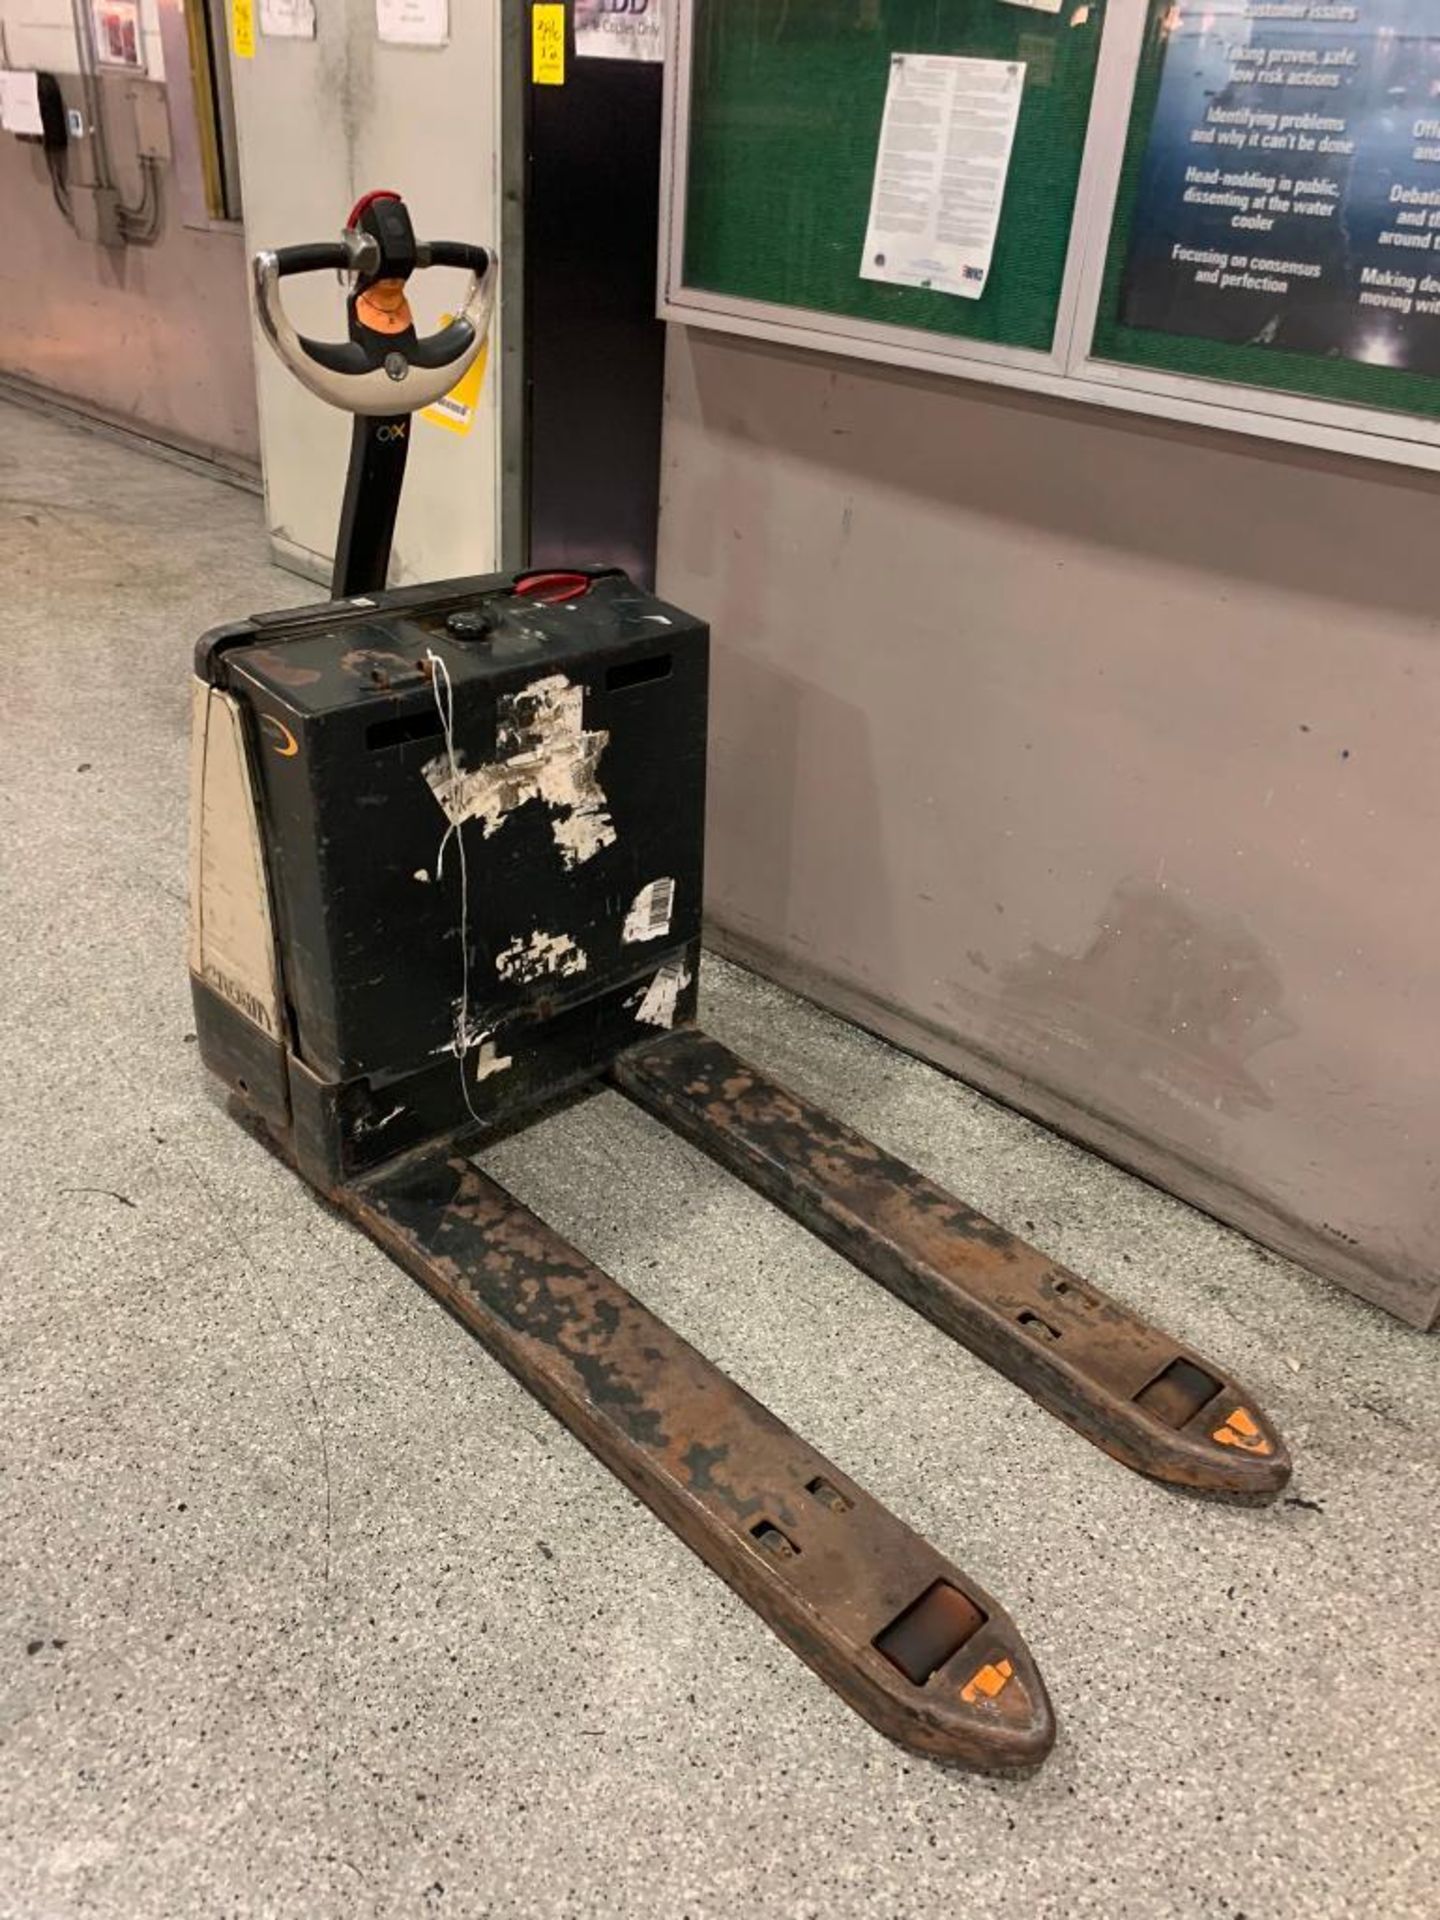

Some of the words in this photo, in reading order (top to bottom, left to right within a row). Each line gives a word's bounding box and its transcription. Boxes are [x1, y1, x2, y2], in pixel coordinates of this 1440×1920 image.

[1228, 64, 1254, 83] low
[1257, 68, 1282, 84] risk
[1287, 70, 1339, 88] actions
[1207, 106, 1277, 131] Identifying
[1278, 112, 1346, 133] problems
[1190, 127, 1215, 143] and
[1217, 129, 1247, 150] why
[1248, 132, 1258, 147] it
[1261, 133, 1296, 149] can't
[1299, 134, 1316, 150] be
[1318, 137, 1355, 154] done
[1185, 165, 1276, 193] Head-nodding
[1278, 174, 1292, 192] in
[1293, 176, 1341, 198] public,
[1183, 186, 1249, 212] dissenting
[1251, 196, 1267, 210] at
[1268, 197, 1291, 213] the
[1293, 201, 1336, 217] water
[1231, 214, 1275, 232] cooler
[1396, 209, 1426, 227] and
[1378, 230, 1430, 249] around
[1171, 243, 1228, 268] Focusing
[1230, 254, 1248, 268] on
[1250, 256, 1322, 279] consensus
[1195, 268, 1220, 284] and
[1219, 273, 1288, 294] perfection
[1361, 267, 1416, 293] Making
[1419, 273, 1440, 292] de
[1359, 290, 1412, 314] moving
